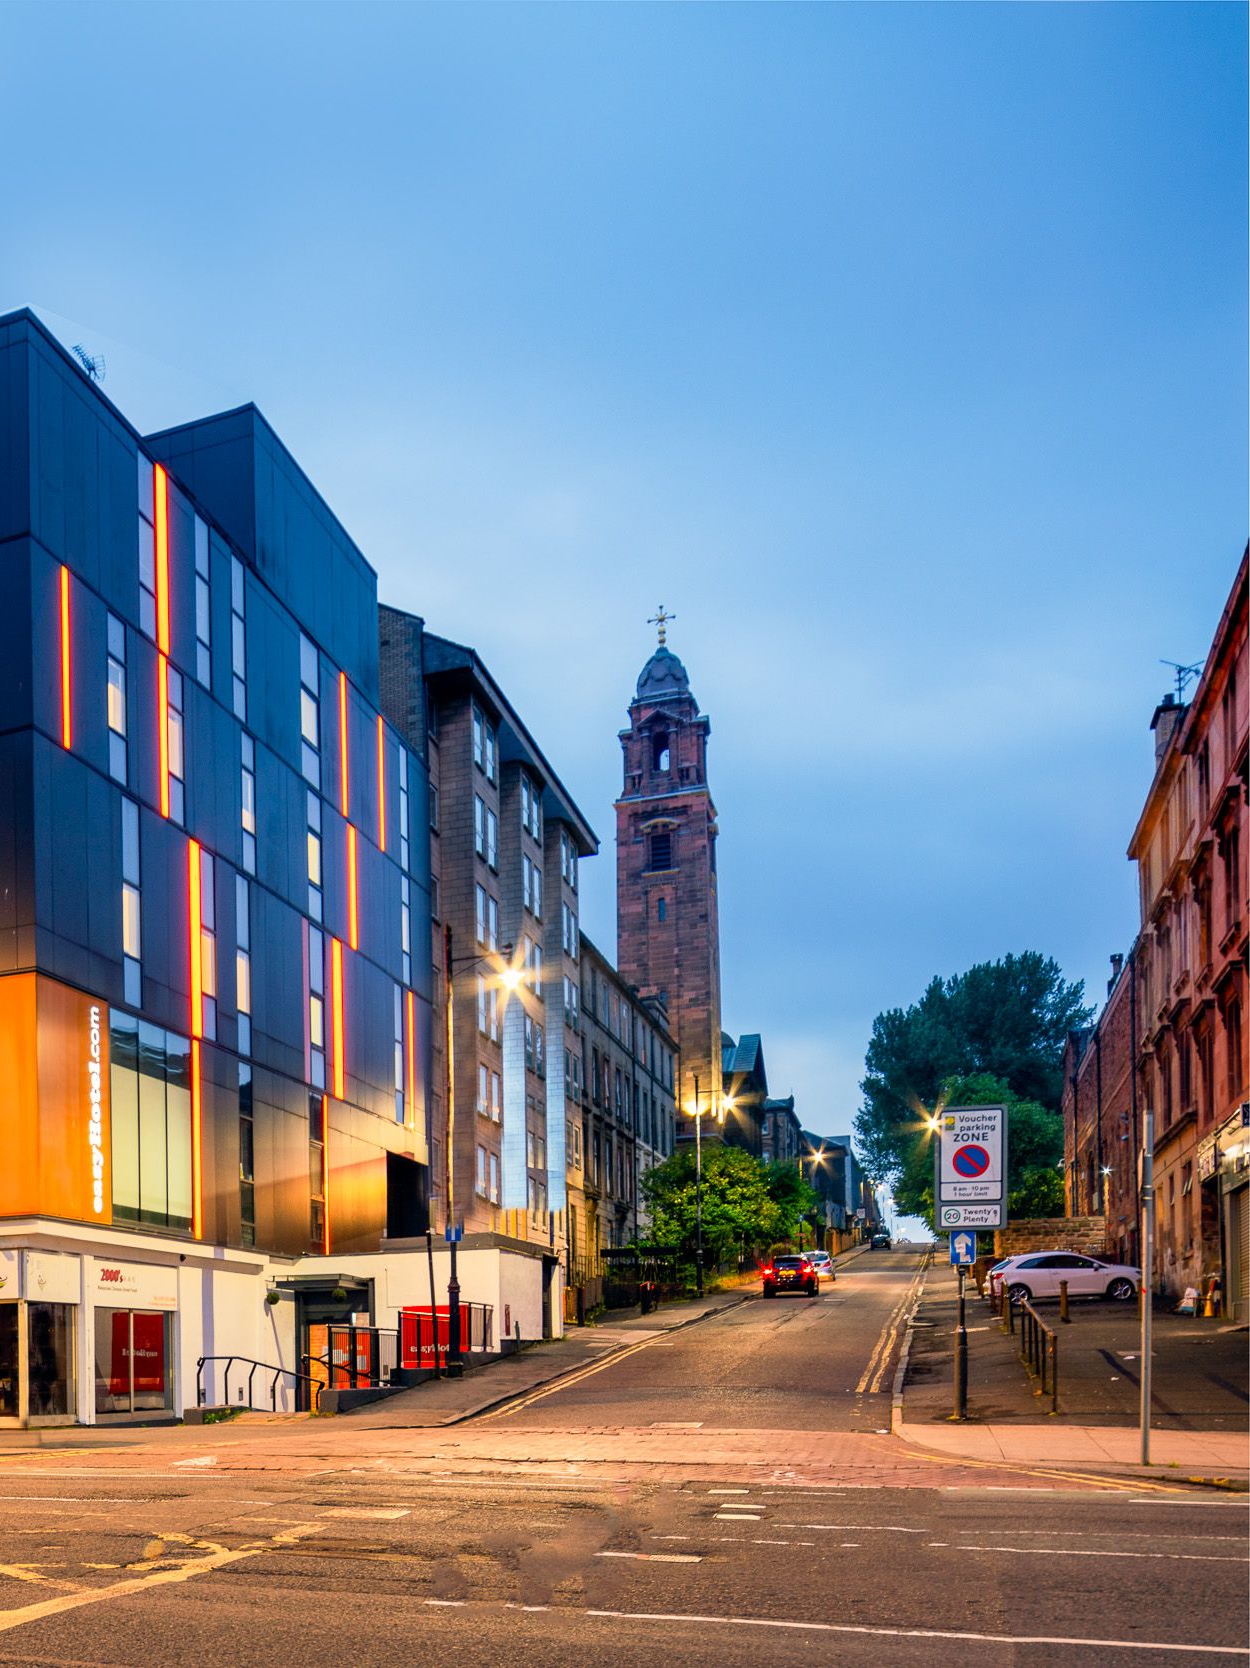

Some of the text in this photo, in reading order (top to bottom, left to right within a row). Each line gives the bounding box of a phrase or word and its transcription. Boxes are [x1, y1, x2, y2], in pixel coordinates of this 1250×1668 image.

[88, 1006, 104, 1214] easyHotel.com
[960, 1124, 996, 1132] parking
[953, 1132, 989, 1142] ZONE
